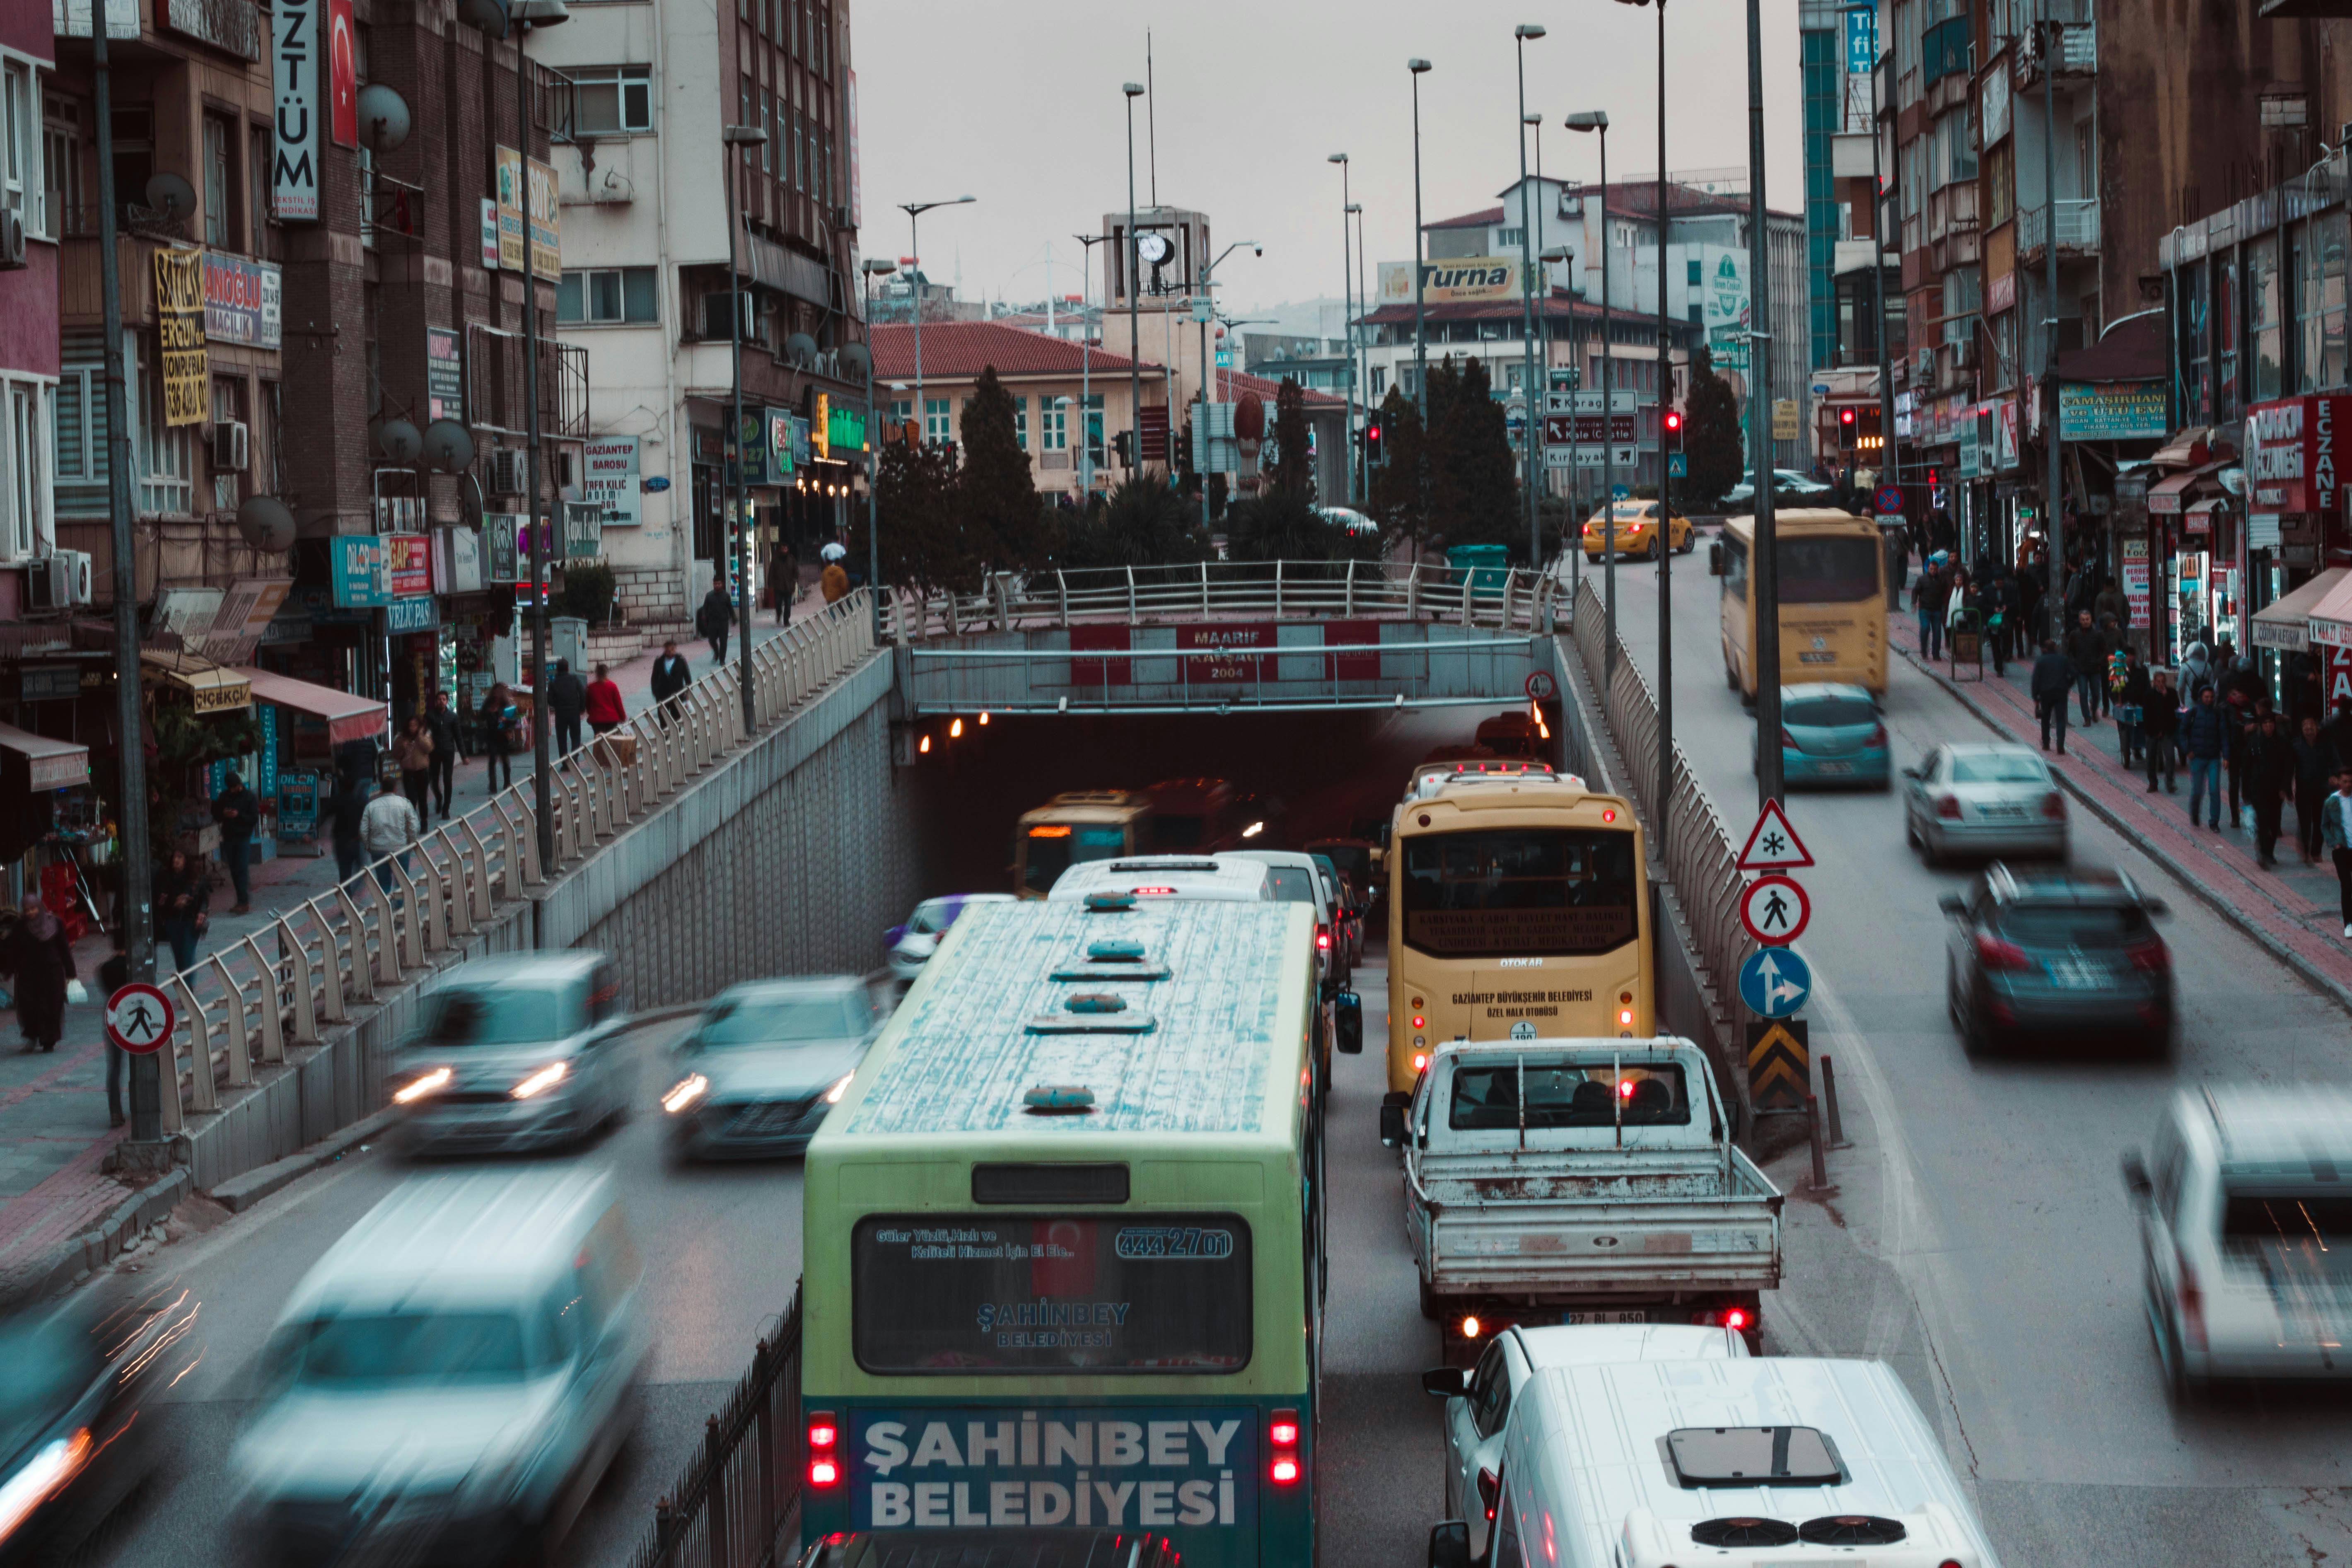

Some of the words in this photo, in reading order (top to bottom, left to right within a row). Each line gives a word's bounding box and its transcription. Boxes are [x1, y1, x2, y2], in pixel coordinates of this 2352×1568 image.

[274, 0, 314, 187] ZTÜM
[510, 161, 548, 222] TESOY
[157, 253, 202, 307] SATILIK
[1422, 265, 1507, 288] Turna
[204, 264, 261, 310] ANOĞLU
[207, 310, 250, 339] IMACILIK
[2094, 382, 2142, 394] GAP
[1565, 399, 1618, 409] Karagz
[2093, 405, 2129, 416] ÜTÜ
[1592, 428, 1633, 440] (Cstle)
[586, 443, 633, 456] GAZİANTEP
[2316, 400, 2335, 508] ECZANE
[593, 460, 627, 470] BAROSU
[1550, 453, 1605, 464] Kırayak
[390, 540, 409, 570] GAP
[2130, 605, 2141, 614] POR
[1194, 628, 1260, 645] MAARİF
[1211, 667, 1244, 679] 2004
[1531, 677, 1540, 695] 4
[195, 685, 245, 708] ÇİÇEKÇİ
[1500, 957, 1543, 967] OTOKAR
[1452, 991, 1495, 1005] GAZİANTEP
[1497, 989, 1546, 1005] BÜYÜKŞEHİR
[1548, 989, 1592, 1002] BELEDİYESİ
[1487, 1007, 1504, 1018] ÖZEL
[1506, 1007, 1524, 1017] HALK
[1526, 1005, 1558, 1016] OTOBÜSÜ
[1521, 1023, 1526, 1032] 1
[876, 1229, 912, 1242] Güler
[981, 1231, 997, 1242] ve
[1120, 1234, 1165, 1255] 444
[1168, 1227, 1202, 1255] 27
[1204, 1233, 1227, 1255] 01
[912, 1244, 955, 1258] Kaliteli
[958, 1244, 1004, 1258] Hizmet
[1005, 1242, 1029, 1261] İçin
[1031, 1244, 1044, 1257] El
[977, 1297, 1130, 1331] ŞAHİNBEY
[1570, 1314, 1585, 1325] 27
[997, 1327, 1112, 1348] BELEDİYESİ
[864, 1411, 1242, 1476] ŞAHİNBEY
[871, 1469, 1236, 1527] BELEDİYESİ
